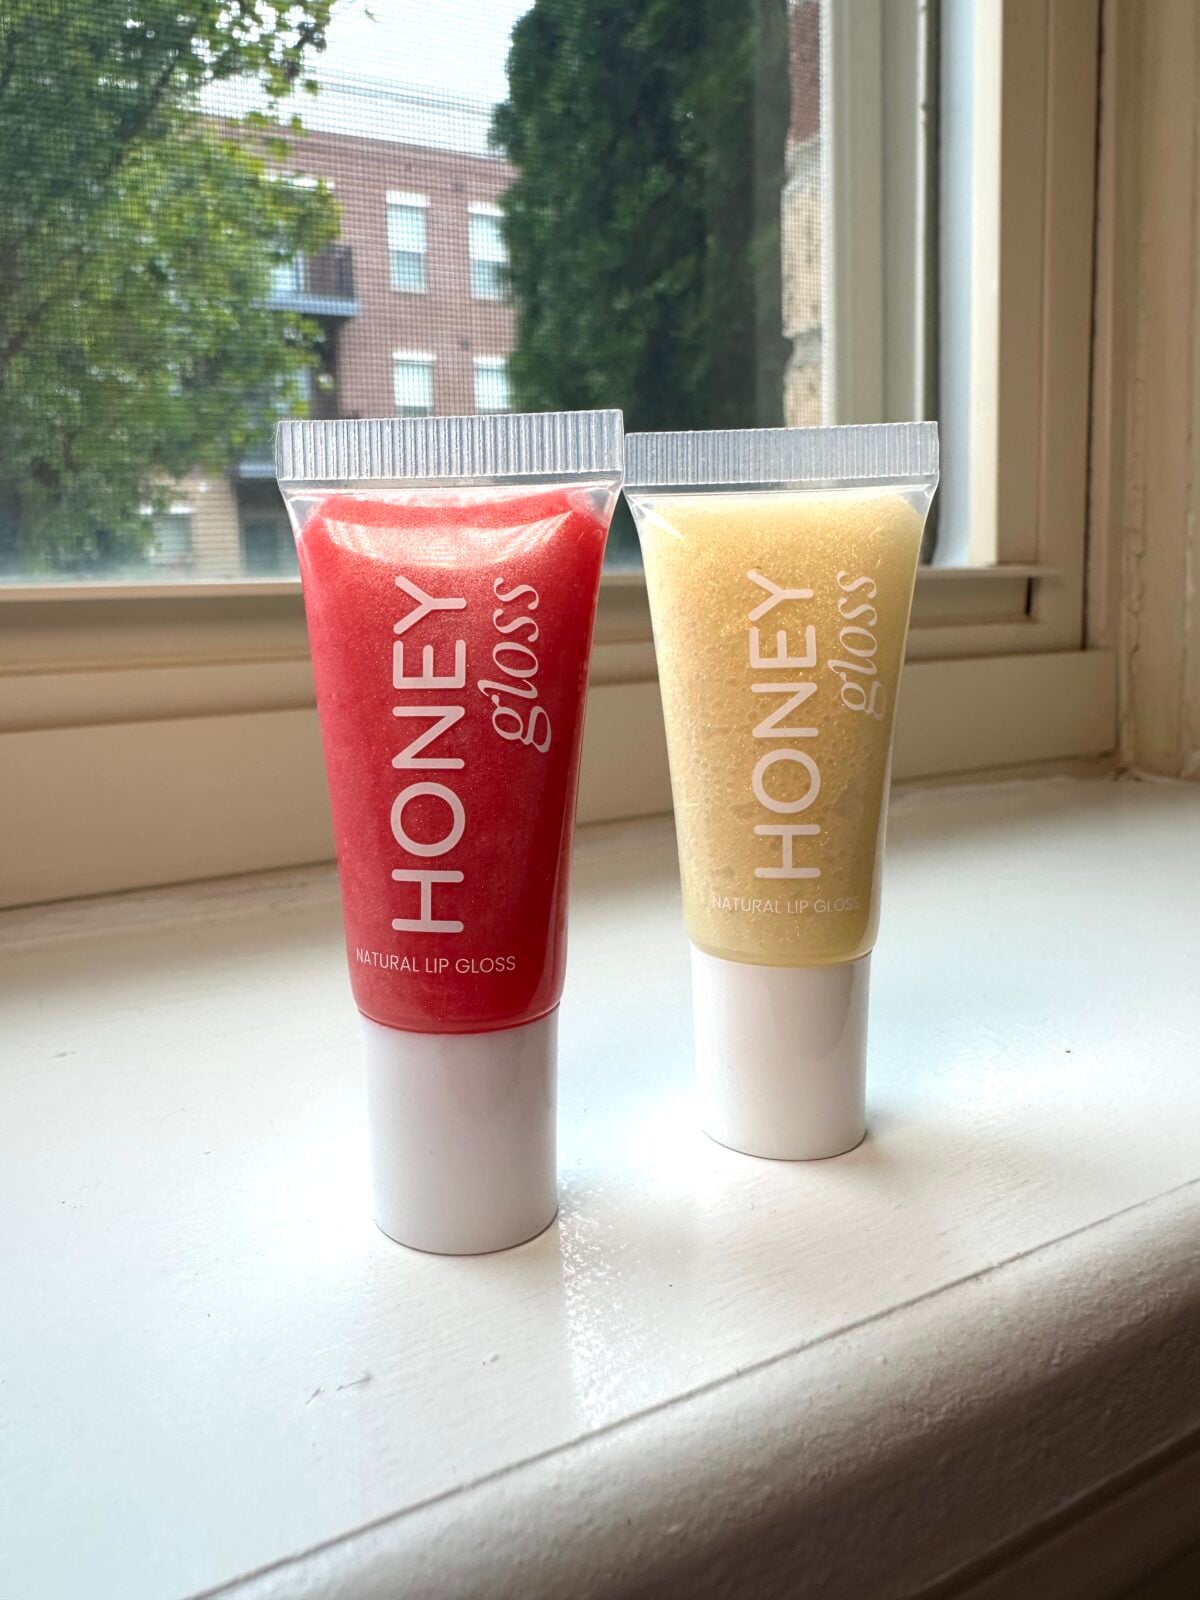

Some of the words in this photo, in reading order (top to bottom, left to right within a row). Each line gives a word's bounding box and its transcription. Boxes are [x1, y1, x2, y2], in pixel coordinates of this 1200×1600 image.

[477, 577, 551, 753] gloss
[746, 569, 821, 878] HONEY
[827, 570, 886, 720] gloss
[391, 575, 467, 933] HONEY
[355, 947, 420, 973] NATURAL
[425, 957, 449, 974] LIP
[455, 955, 516, 974] GLOSS
[711, 895, 782, 914] NATURAL
[787, 900, 809, 914] LIP
[814, 896, 861, 914] GLOSS
